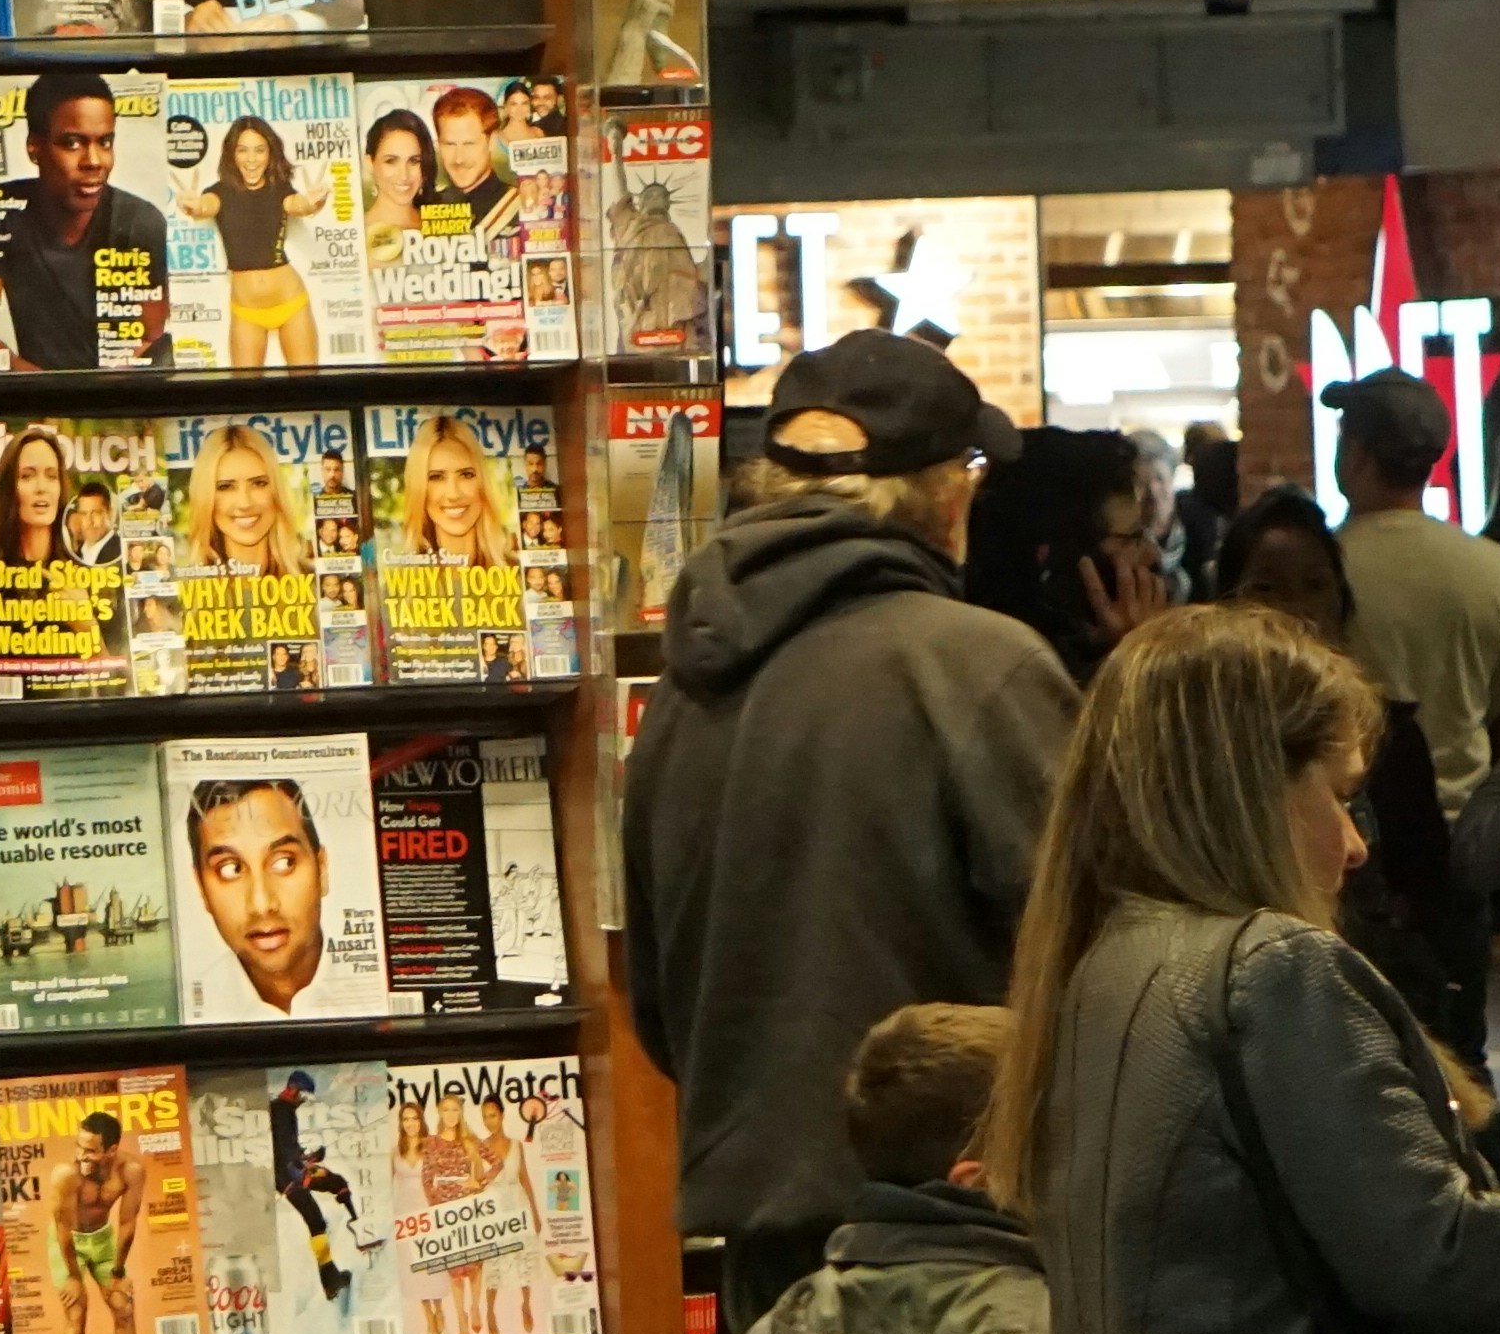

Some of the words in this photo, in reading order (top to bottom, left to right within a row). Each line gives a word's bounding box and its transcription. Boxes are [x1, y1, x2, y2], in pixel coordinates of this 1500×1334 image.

[622, 125, 705, 157] NYC
[94, 248, 151, 267] Chris
[401, 226, 488, 268] Royal
[96, 267, 150, 287] Rock
[96, 301, 142, 319] Place
[626, 405, 711, 435] NYC
[48, 561, 121, 593] Stops
[385, 567, 444, 597] WHY
[446, 566, 456, 596] I
[459, 565, 522, 596] TOOK
[385, 597, 458, 628] TAREK
[461, 596, 523, 628] BACK
[182, 748, 203, 763] The
[205, 747, 269, 763] Reactionary
[270, 745, 356, 760] Counterculture
[13, 818, 87, 840] world's
[91, 816, 143, 837] most
[60, 840, 148, 861] resource
[380, 830, 469, 861] FIRED
[342, 919, 375, 936] Aziz
[326, 936, 378, 954] Ansari
[0, 1143, 46, 1162] RUSH
[413, 1228, 471, 1259] You'll
[473, 1213, 530, 1248] Love!
